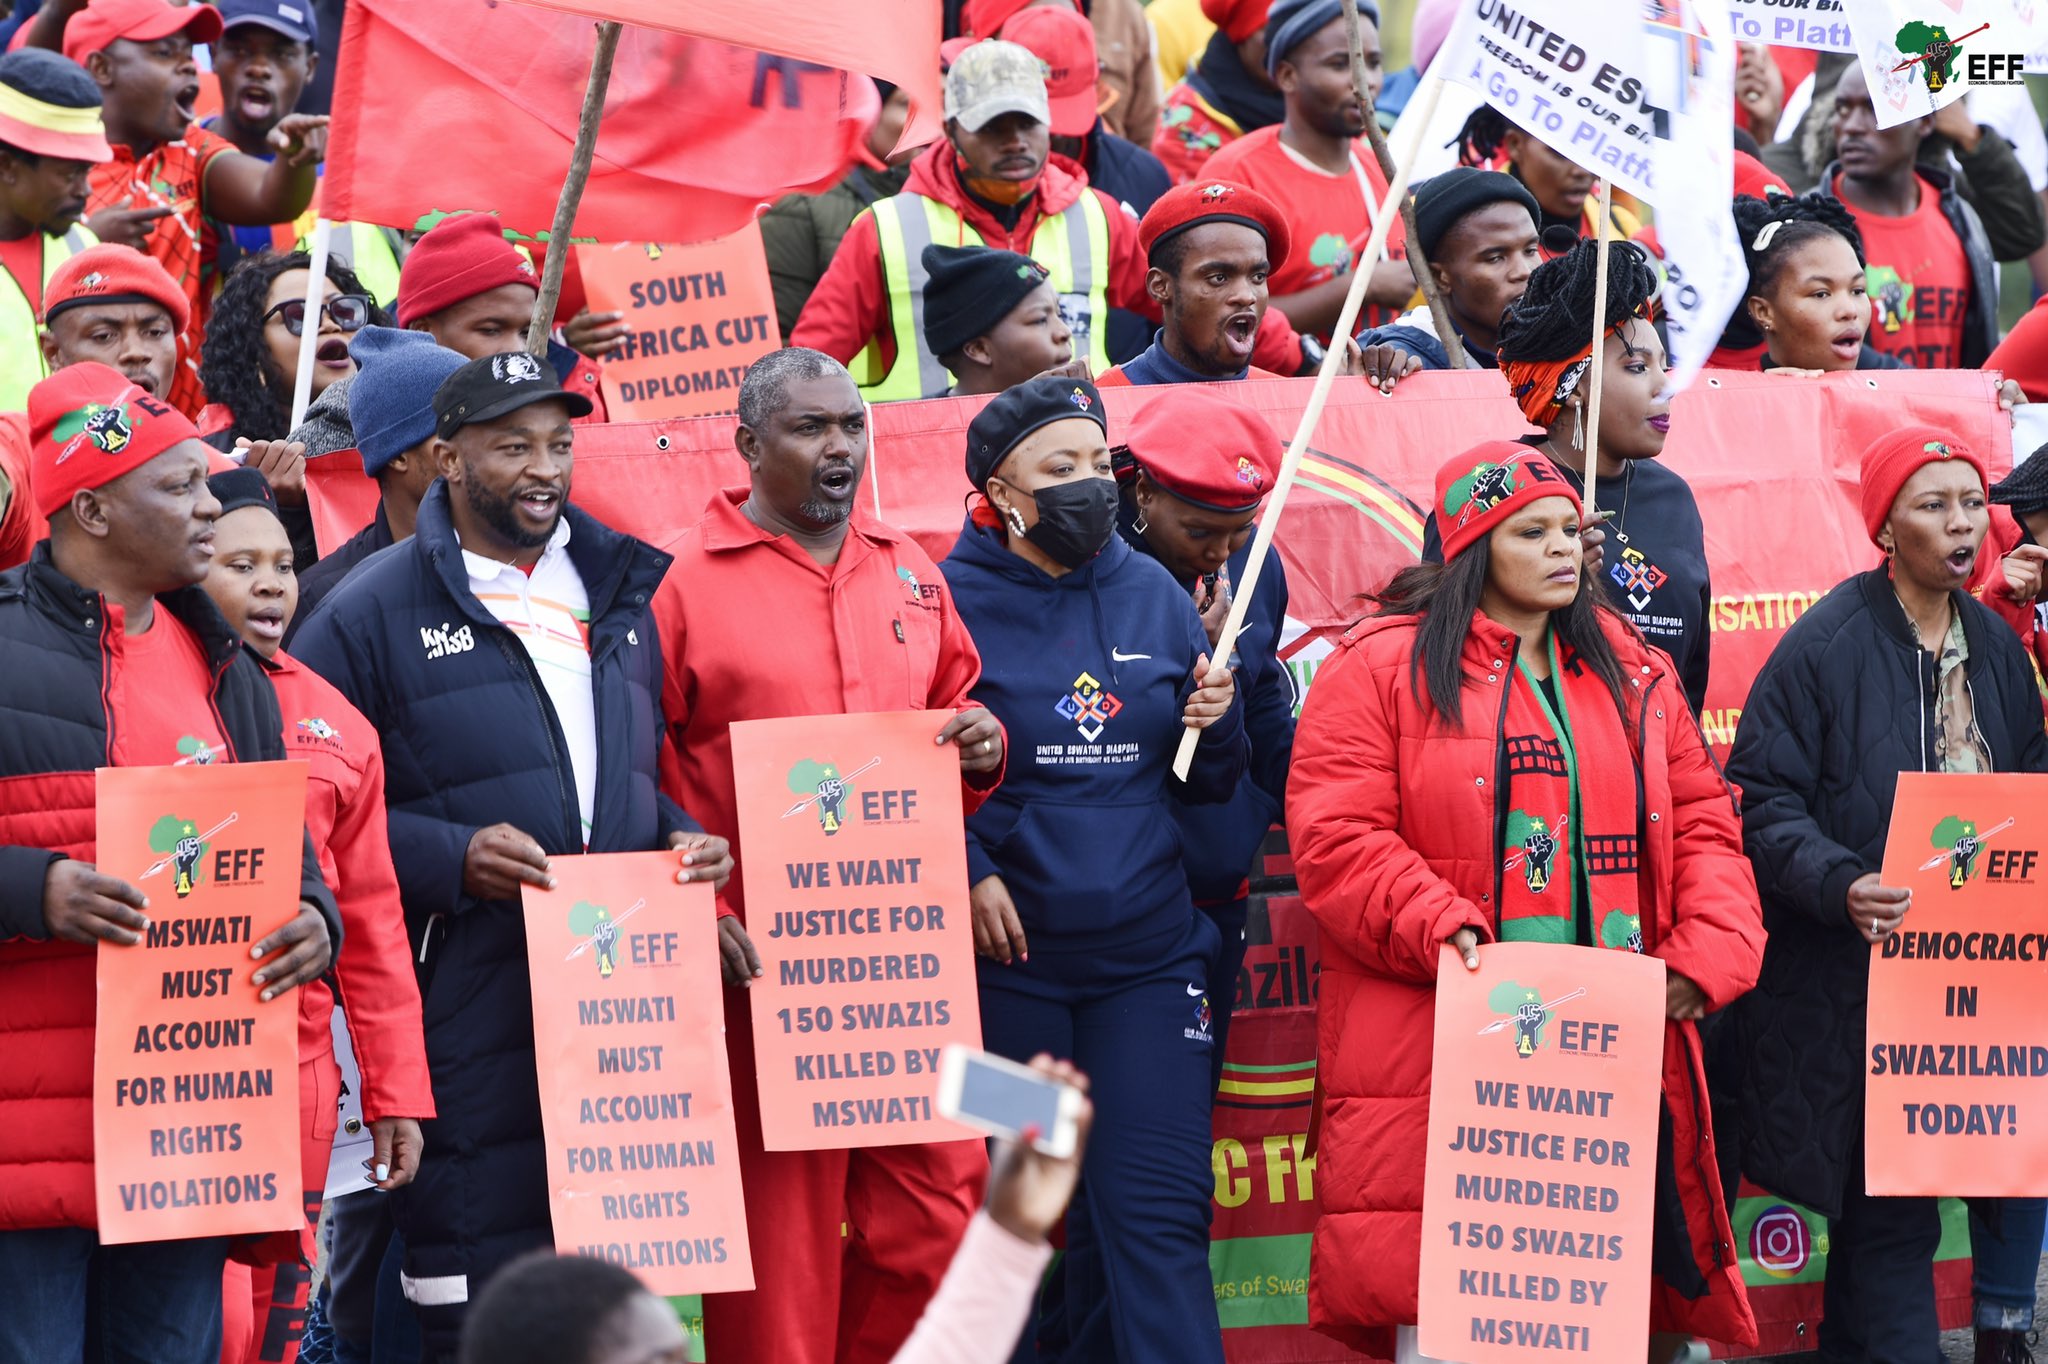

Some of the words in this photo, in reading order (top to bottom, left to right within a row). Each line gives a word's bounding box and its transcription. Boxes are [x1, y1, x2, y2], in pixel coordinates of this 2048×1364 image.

[1476, 0, 1586, 72] UNITED
[1729, 11, 1761, 37] To
[1469, 58, 1481, 80] A
[1488, 71, 1518, 107] Go
[1530, 94, 1563, 132] To
[1479, 34, 1549, 84] FREEDOM
[1552, 82, 1573, 97] IS
[1577, 96, 1621, 126] OUR
[630, 272, 726, 308] SOUTH
[716, 315, 768, 346] CUT
[1036, 745, 1063, 756] UNITED
[1067, 744, 1102, 756] ESWATINI
[1106, 742, 1139, 755] DIASPORA
[862, 790, 916, 820] EFF
[215, 848, 264, 881] EFF
[787, 863, 830, 888] WE
[837, 858, 921, 886] WANT
[1987, 851, 2038, 878] EFF
[147, 916, 251, 948] MSWATI
[769, 908, 880, 938] JUSTICE
[889, 906, 944, 932] FOR
[631, 933, 678, 963] EFF
[1881, 932, 2048, 961] DEMOCRACY
[162, 968, 232, 999] MUST
[780, 954, 940, 985] MURDERED
[579, 996, 675, 1024] MSWATI
[777, 1006, 833, 1033] 150
[842, 1000, 950, 1030] SWAZIS
[1946, 986, 1977, 1016] IN
[134, 1019, 255, 1053] ACCOUNT
[1560, 1020, 1618, 1052] EFF
[598, 1046, 662, 1073] MUST
[796, 1051, 895, 1080] KILLED
[905, 1048, 940, 1074] BY
[1871, 1044, 2048, 1077] SWAZILAND
[117, 1077, 165, 1106] FOR
[175, 1069, 272, 1102] HUMAN
[1475, 1081, 1518, 1108] WE
[1527, 1086, 1613, 1117] WANT
[580, 1093, 692, 1123] ACCOUNT
[813, 1096, 930, 1127] MSWATI
[1903, 1104, 2016, 1135] TODAY!
[151, 1123, 242, 1156] RIGHTS
[1449, 1126, 1564, 1160] JUSTICE
[1574, 1138, 1630, 1167] FOR
[567, 1147, 613, 1173] FOR
[620, 1141, 714, 1170] HUMAN
[120, 1173, 277, 1211] VIOLATIONS
[602, 1191, 689, 1219] RIGHTS
[1456, 1174, 1619, 1212] MURDERED
[1448, 1222, 1503, 1249] 150
[1512, 1227, 1622, 1261] SWAZIS
[1241, 1275, 1261, 1297] of
[1460, 1270, 1560, 1301] KILLED
[1570, 1280, 1607, 1306] BY
[1472, 1318, 1589, 1351] MSWATI
